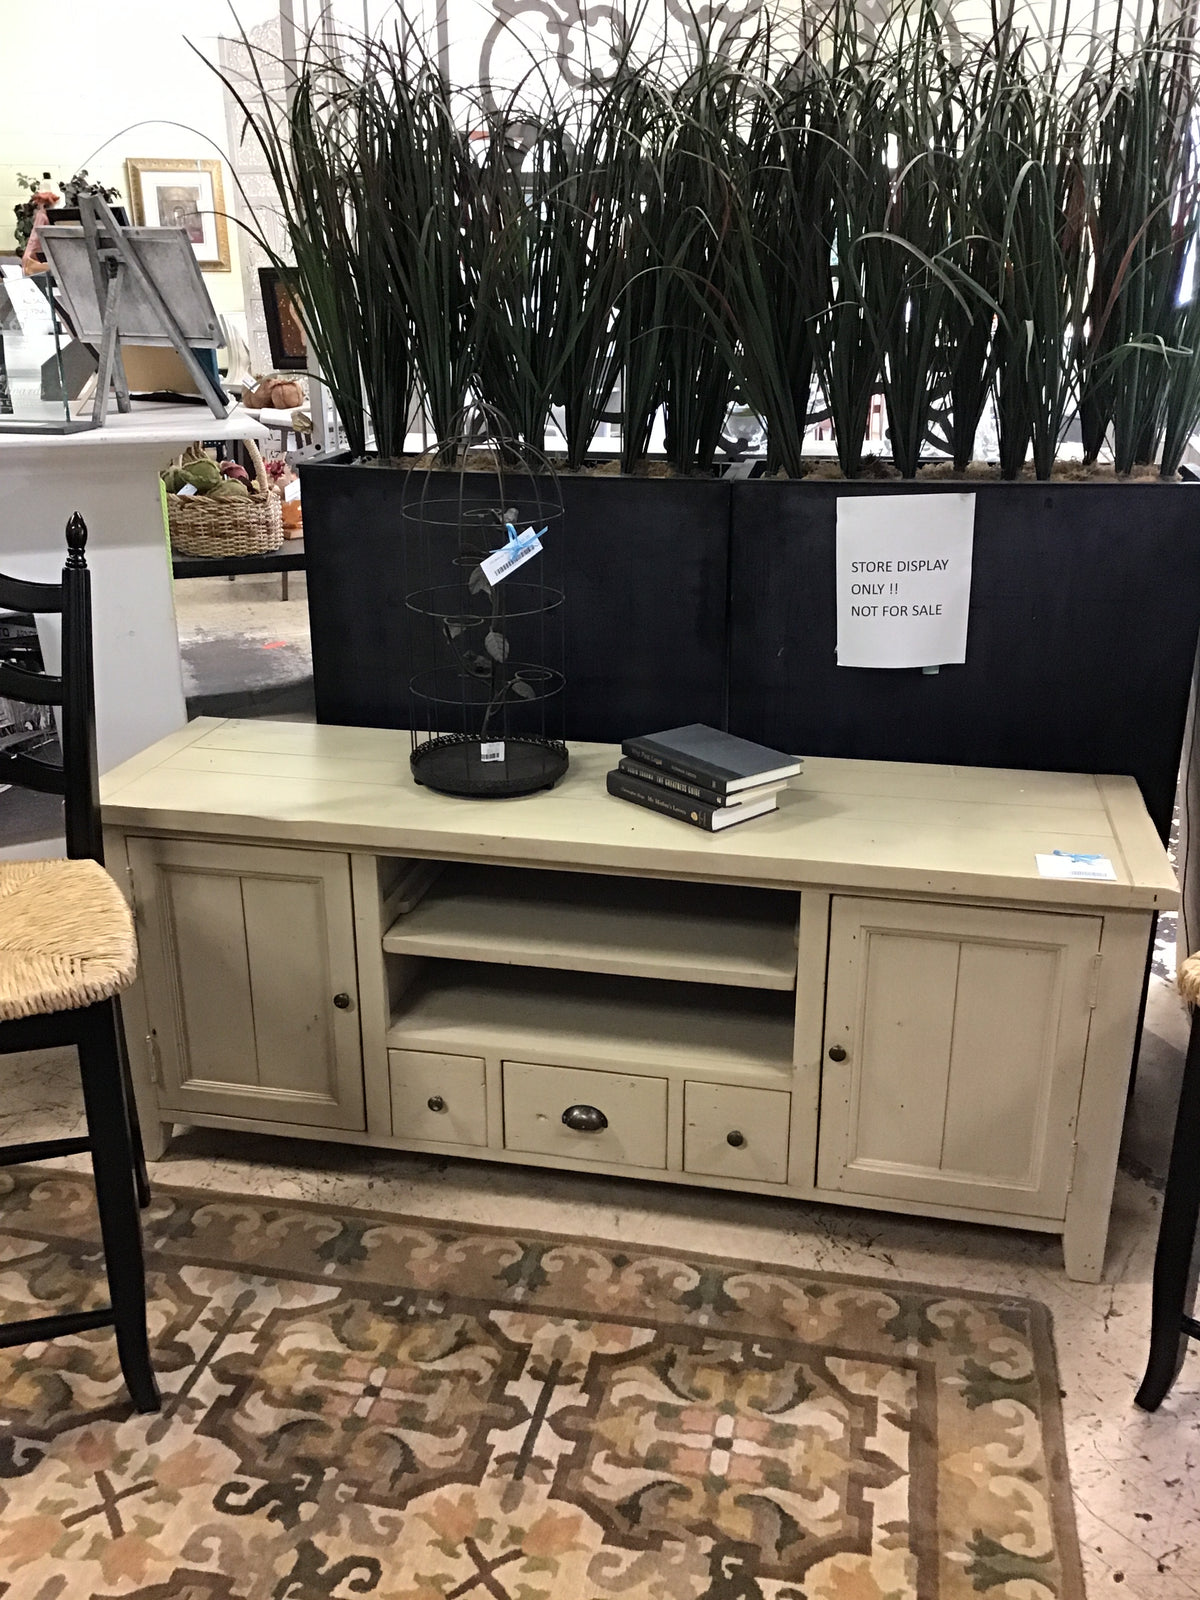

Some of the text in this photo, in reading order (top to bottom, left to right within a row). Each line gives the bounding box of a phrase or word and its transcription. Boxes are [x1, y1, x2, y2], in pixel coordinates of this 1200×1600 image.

[851, 559, 949, 573] STORE DISPLAY
[851, 582, 899, 595] ONLY !!
[851, 604, 943, 617] NOT FOR SALE
